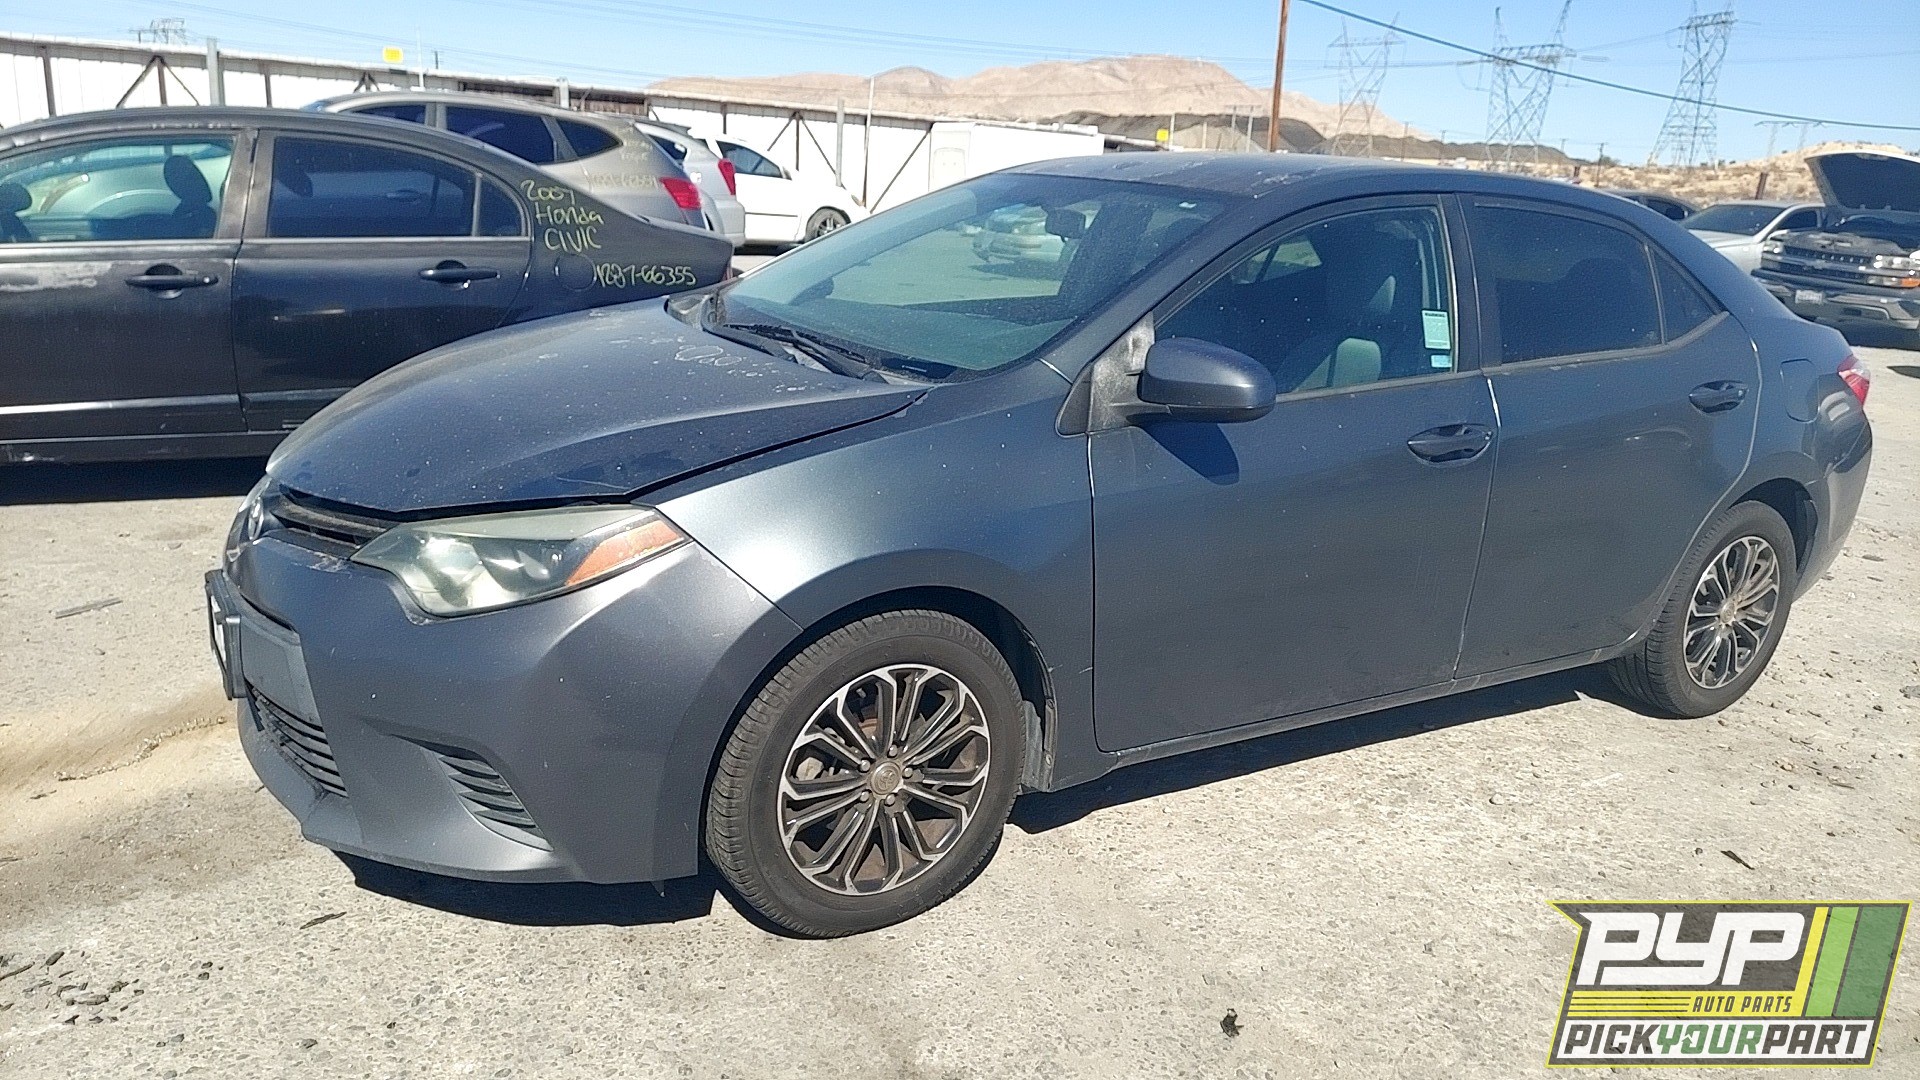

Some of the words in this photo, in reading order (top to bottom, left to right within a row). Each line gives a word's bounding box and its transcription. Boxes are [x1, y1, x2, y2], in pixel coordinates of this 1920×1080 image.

[520, 180, 575, 205] 2007
[535, 202, 604, 225] Honda
[544, 226, 602, 252] CIVIC
